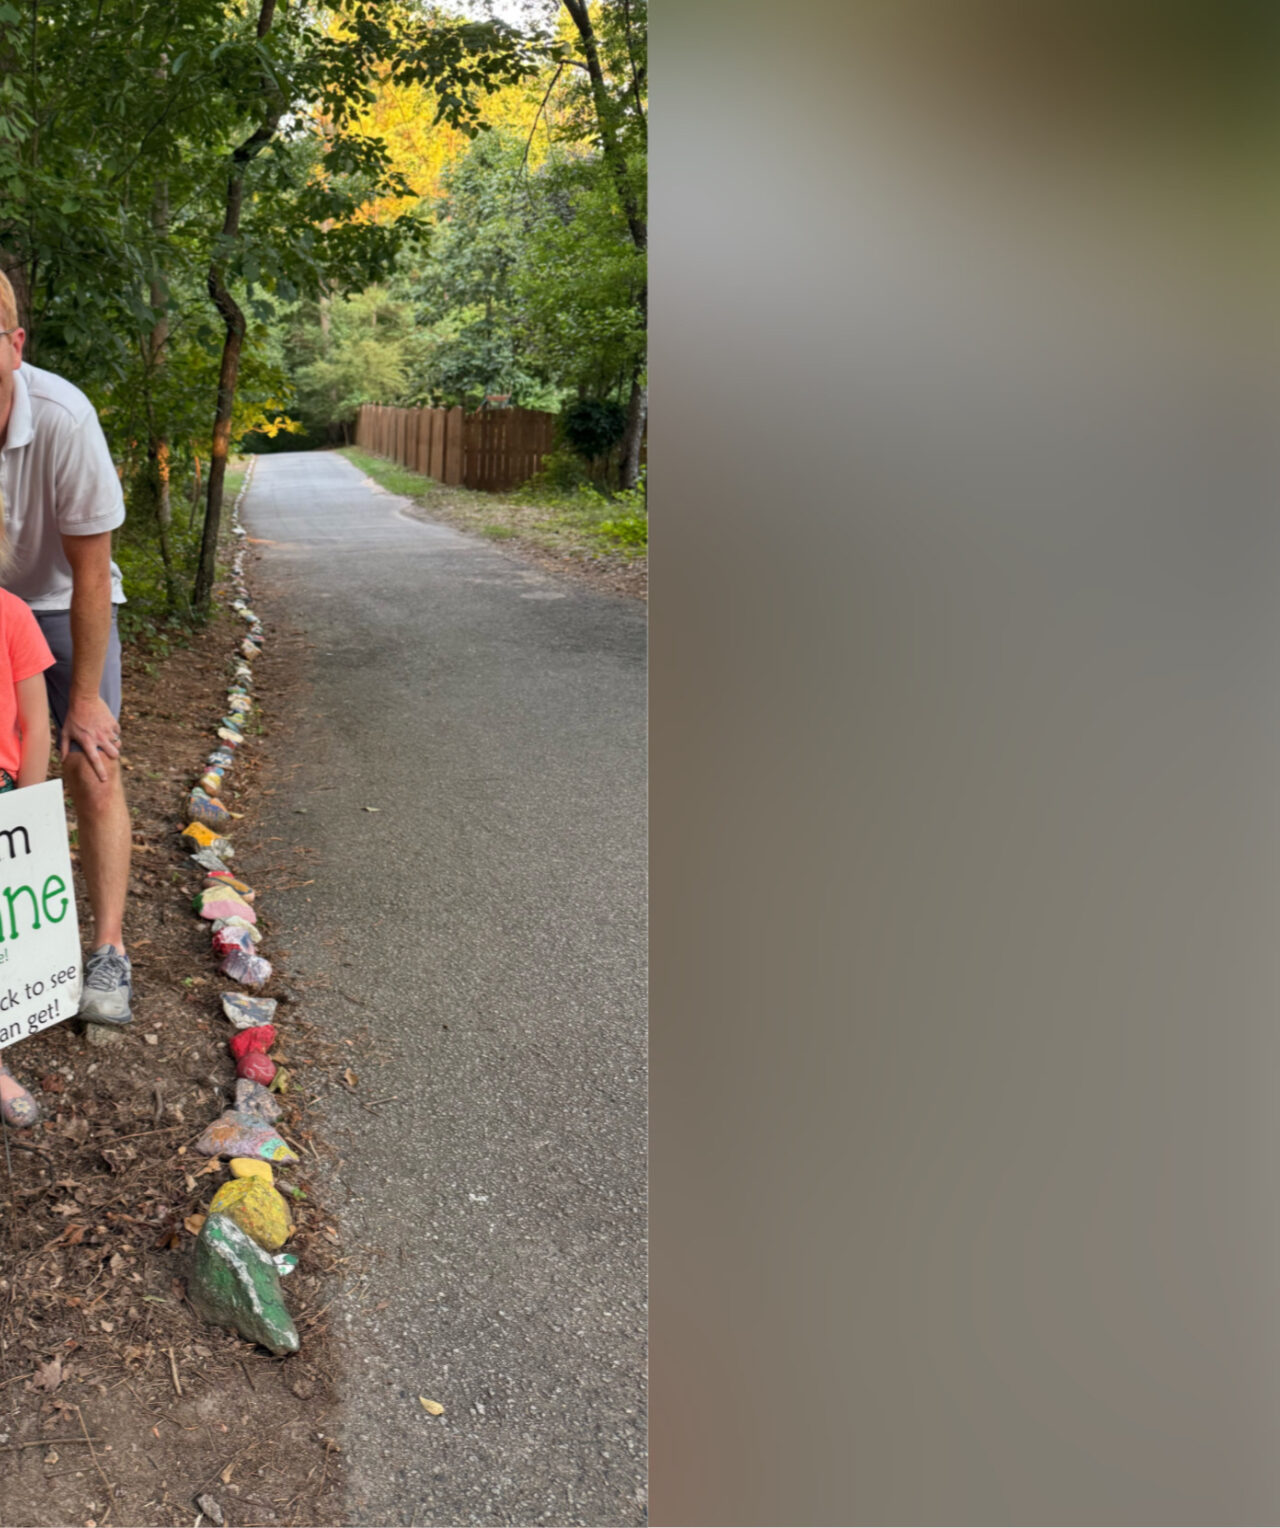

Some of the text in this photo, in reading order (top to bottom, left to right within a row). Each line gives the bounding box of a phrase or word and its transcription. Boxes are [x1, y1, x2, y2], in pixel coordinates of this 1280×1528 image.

[25, 981, 45, 999] to
[50, 965, 77, 988] see
[27, 998, 60, 1034] get!
